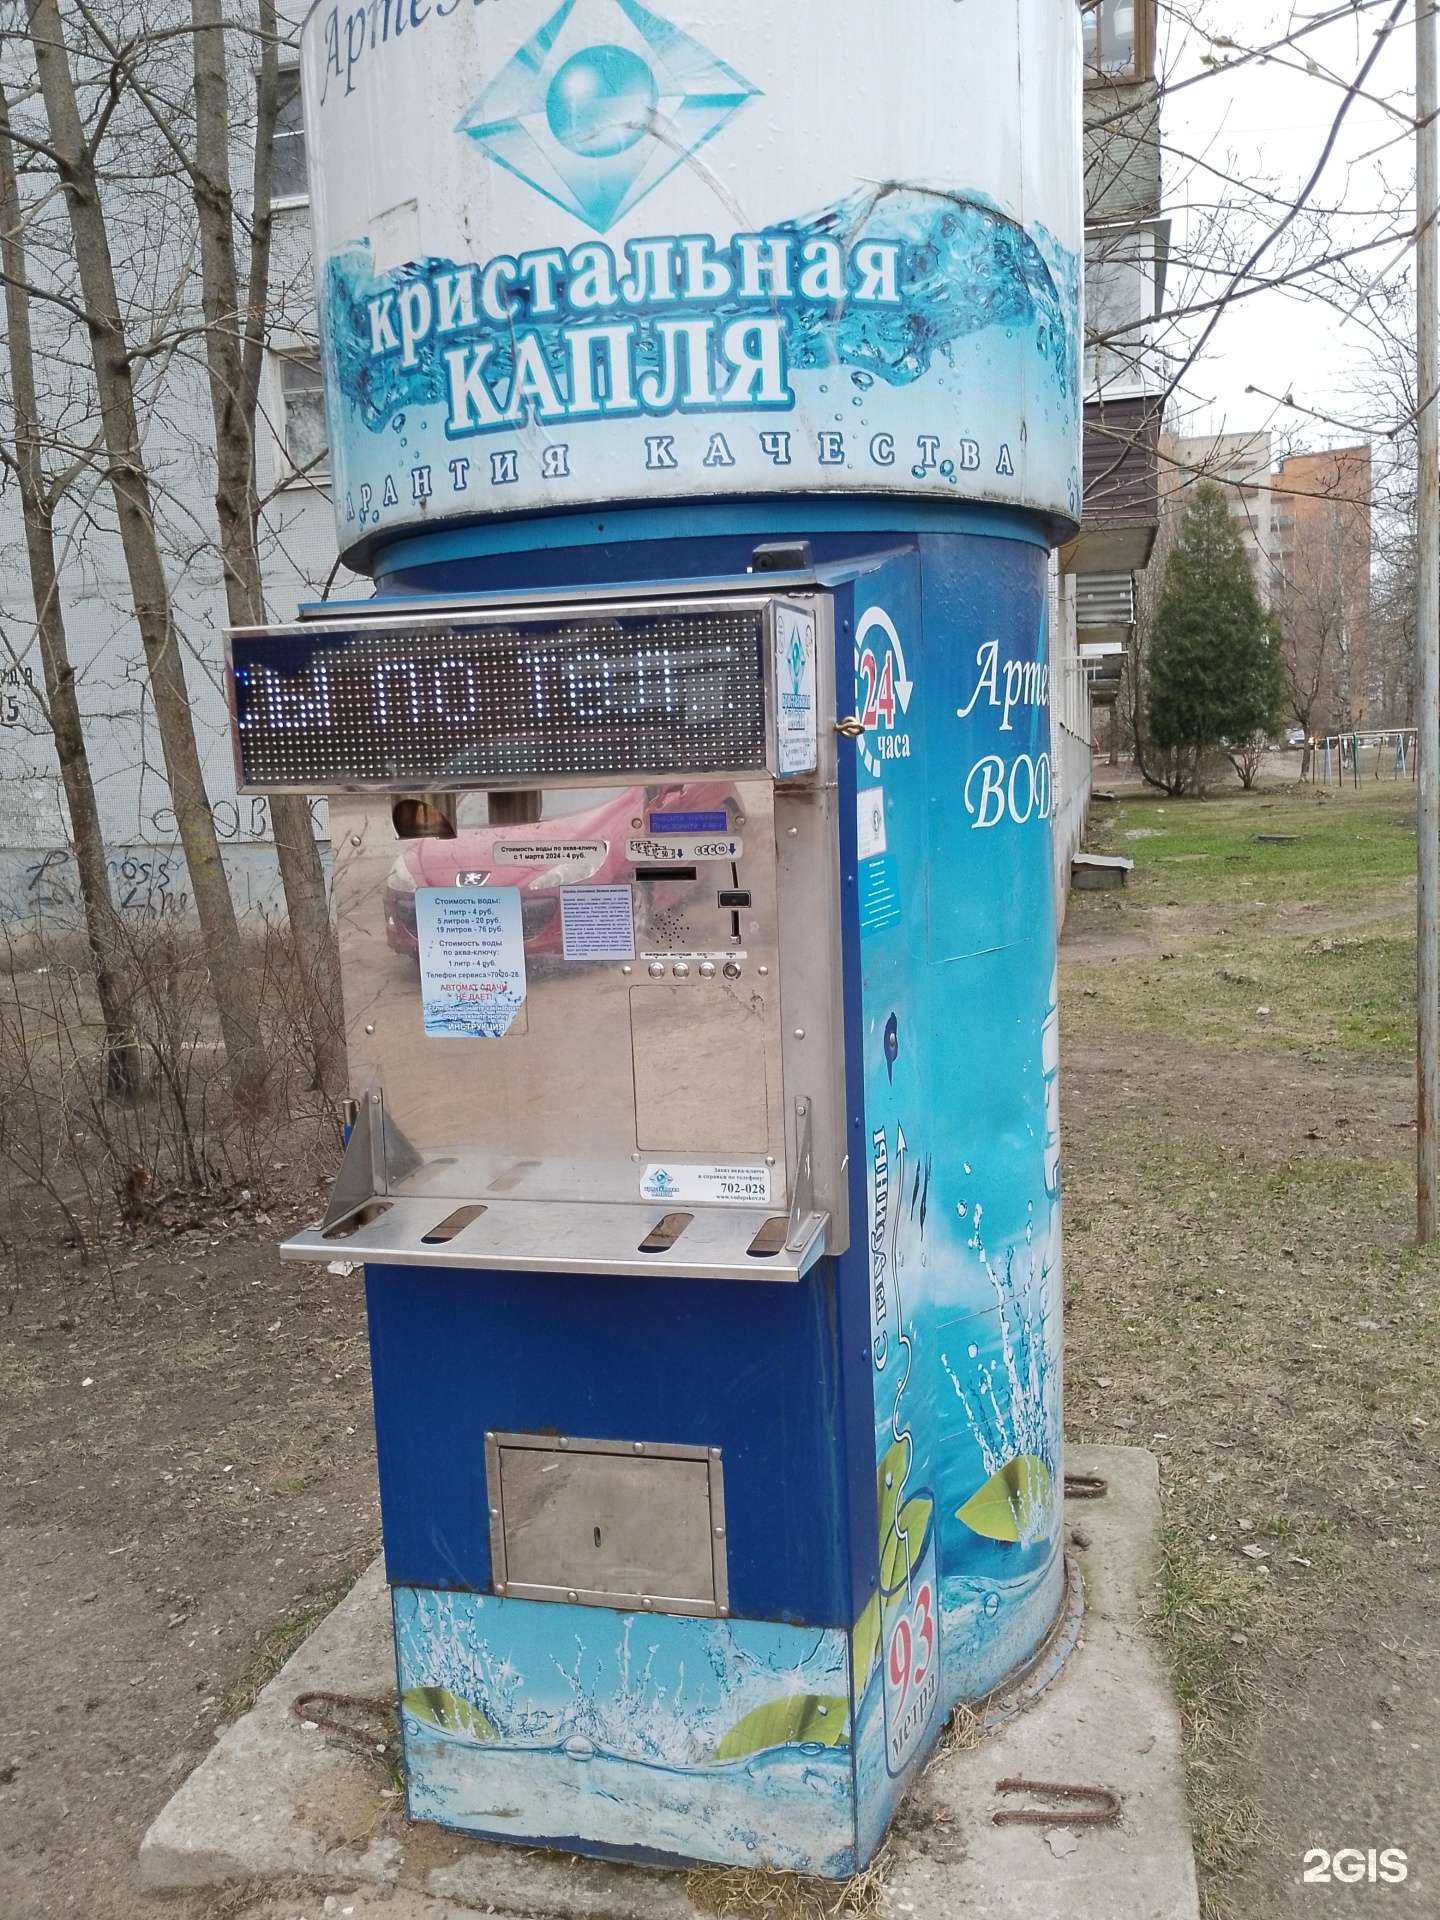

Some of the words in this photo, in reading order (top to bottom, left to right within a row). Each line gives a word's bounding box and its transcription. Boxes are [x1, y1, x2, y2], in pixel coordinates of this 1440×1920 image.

[320, 0, 497, 107] Арте
[363, 233, 903, 369] кристальная
[443, 315, 791, 436] КАПЛЯ
[645, 431, 1014, 477] КАЧЕСТВА
[860, 648, 896, 730] 24
[957, 639, 1050, 732] Арте
[877, 733, 911, 760] часа
[478, 909, 494, 917] руб.
[486, 918, 501, 926] руб.
[488, 926, 504, 934] руб.
[480, 984, 508, 992] СДАЧИ
[720, 1182, 765, 1194] 702-028
[889, 1583, 934, 1729] 93
[891, 1672, 937, 1762] метра
